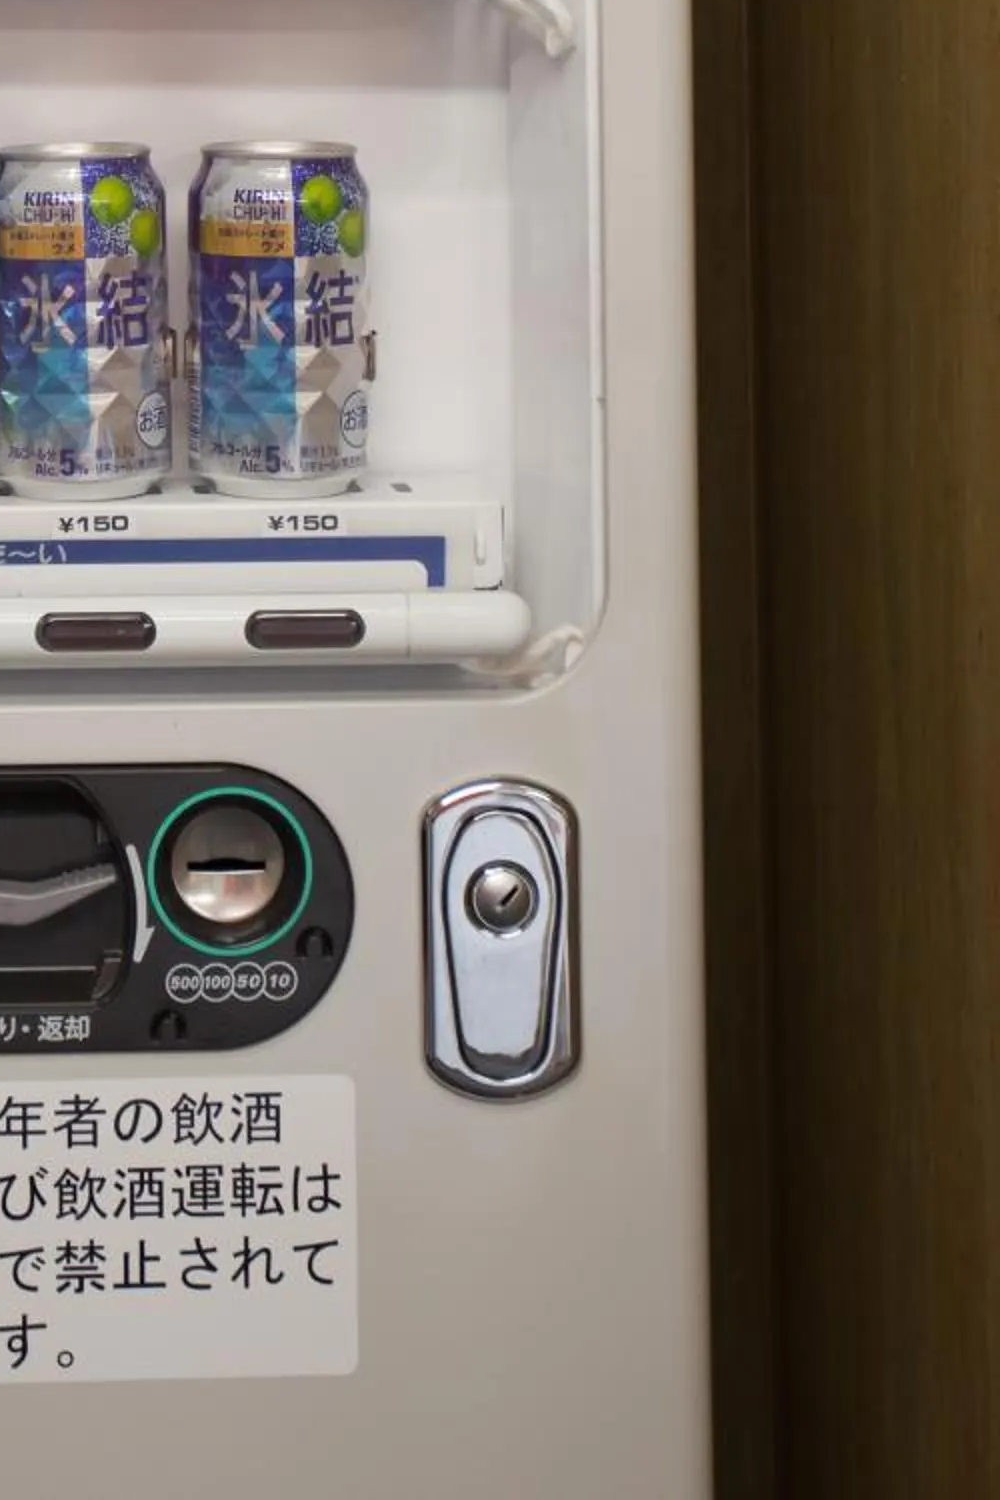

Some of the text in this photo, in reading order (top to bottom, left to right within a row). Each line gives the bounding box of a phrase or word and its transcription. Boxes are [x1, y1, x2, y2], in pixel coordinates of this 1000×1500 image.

[24, 191, 75, 207] KIRIN
[234, 188, 285, 203] KIRIN
[24, 207, 76, 223] CHU-HI
[233, 205, 286, 221] CHU-HI
[19, 270, 152, 353] 氷結
[225, 268, 355, 351] 氷結
[59, 515, 129, 532] ¥150
[268, 514, 338, 531] ¥150
[171, 975, 199, 990] 500
[205, 975, 231, 990] 100
[237, 974, 261, 989] 50
[270, 974, 291, 989] 10
